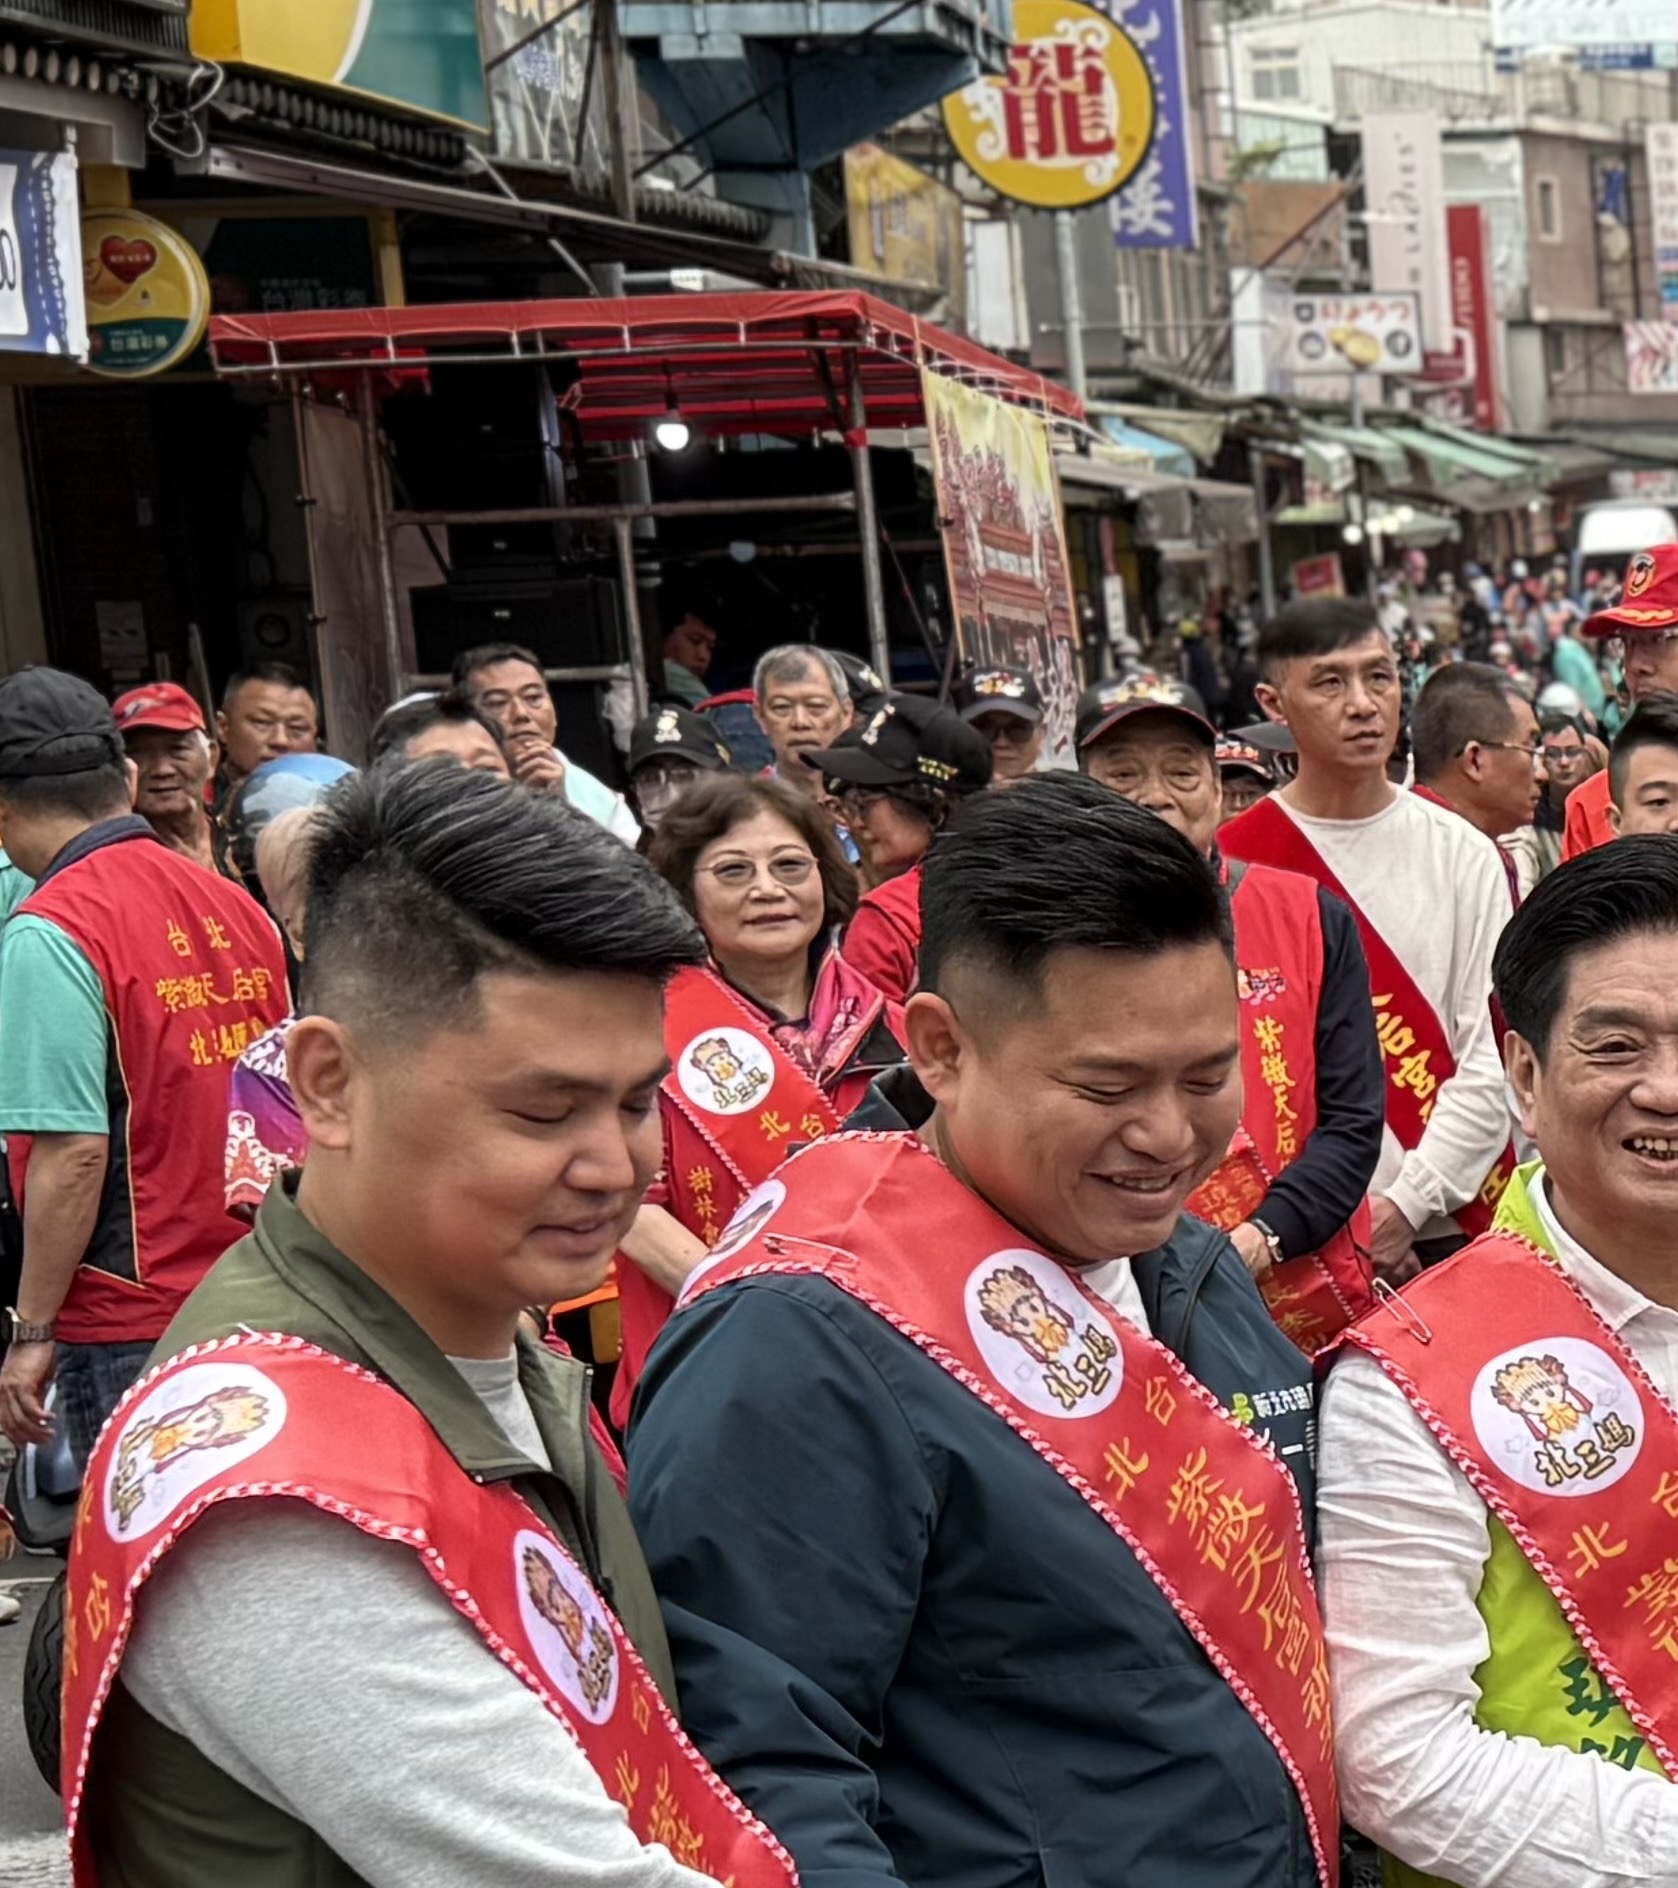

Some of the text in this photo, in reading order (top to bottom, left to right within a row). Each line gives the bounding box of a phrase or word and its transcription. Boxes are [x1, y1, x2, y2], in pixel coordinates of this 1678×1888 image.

[1003, 43, 1116, 160] 龍
[166, 916, 231, 957] 台北
[1253, 1014, 1298, 1168] 紫微天后
[1042, 1323, 1117, 1410] 北三媽
[1534, 1412, 1635, 1486] 北三媽
